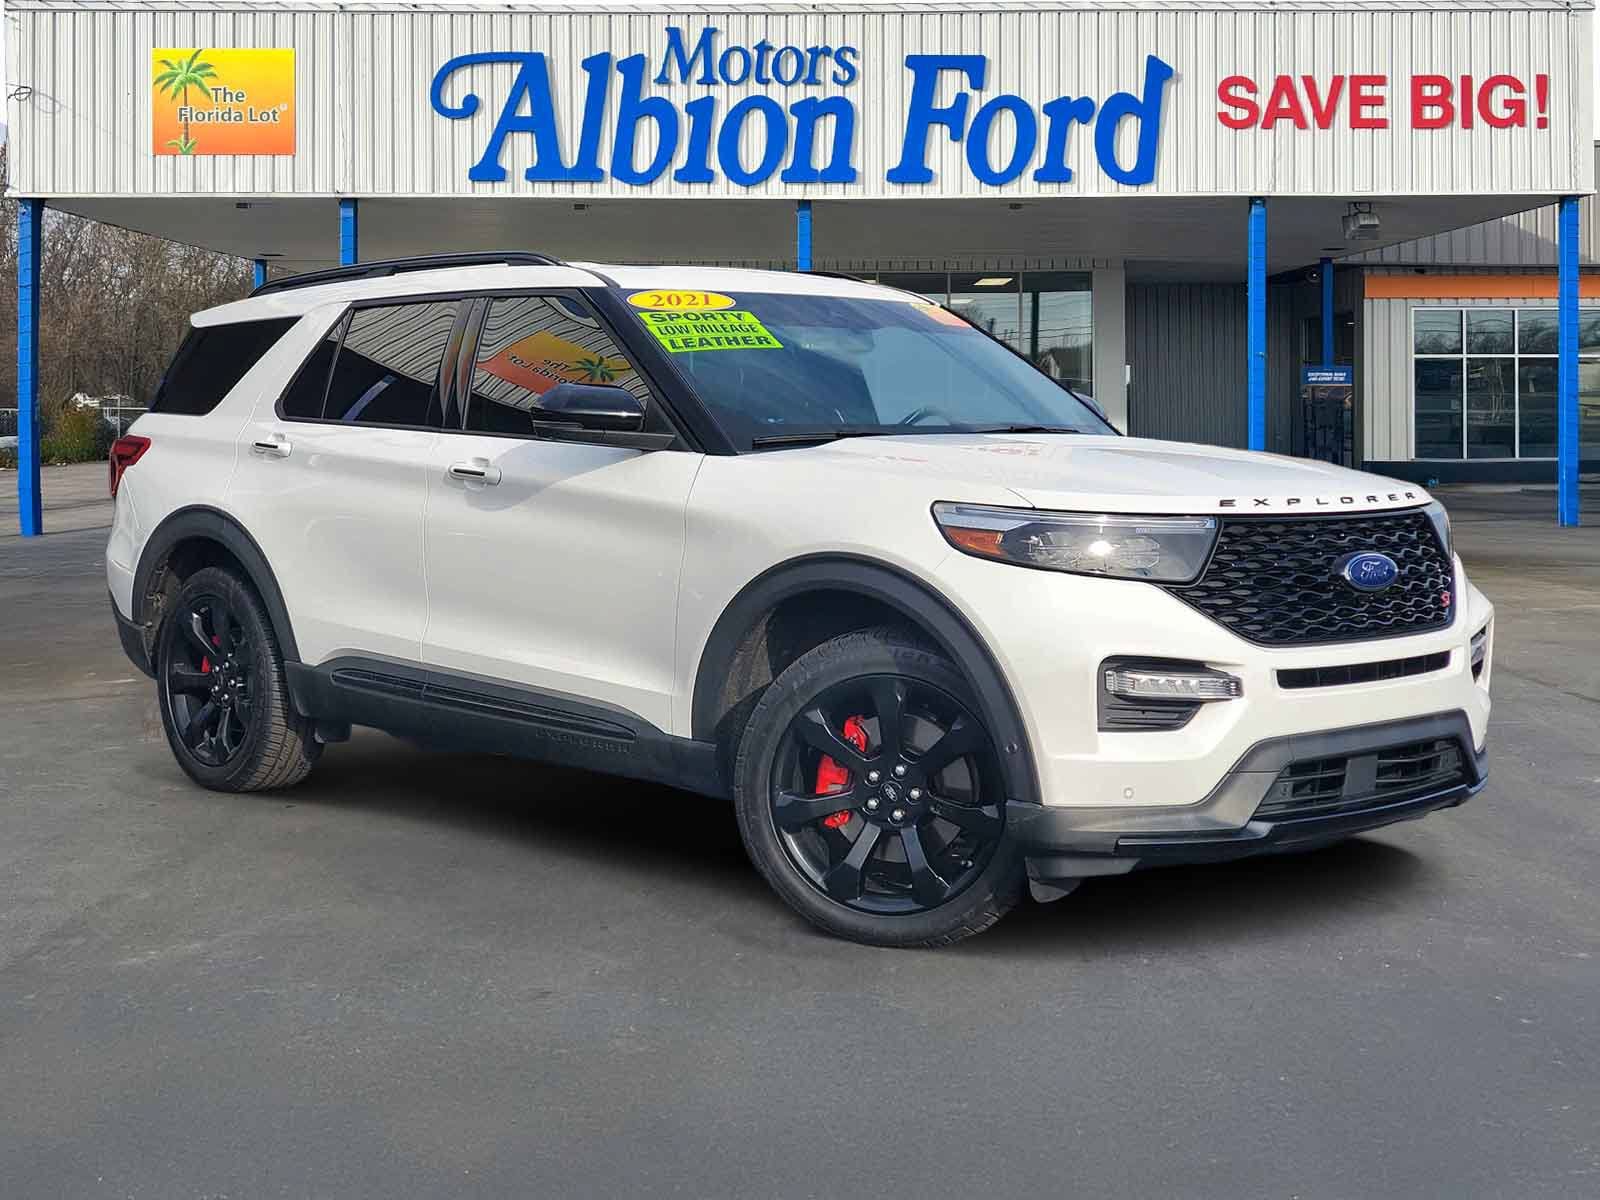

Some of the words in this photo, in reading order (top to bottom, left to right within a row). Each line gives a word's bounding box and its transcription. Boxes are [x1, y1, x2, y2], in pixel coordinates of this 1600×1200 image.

[653, 27, 858, 87] Motors
[211, 87, 246, 103] The
[1217, 74, 1388, 130] SAVE
[1411, 74, 1549, 130] BIG!
[178, 106, 243, 123] Florida
[248, 107, 279, 123] Lot
[430, 51, 857, 187] Albion
[886, 54, 1174, 187] Ford
[650, 294, 713, 308] 2021
[650, 311, 745, 323] SPORTY
[657, 324, 689, 336] LOW
[694, 323, 759, 335] MILEAGE
[669, 336, 772, 350] LEATHER
[1219, 491, 1417, 508] EXPLORER
